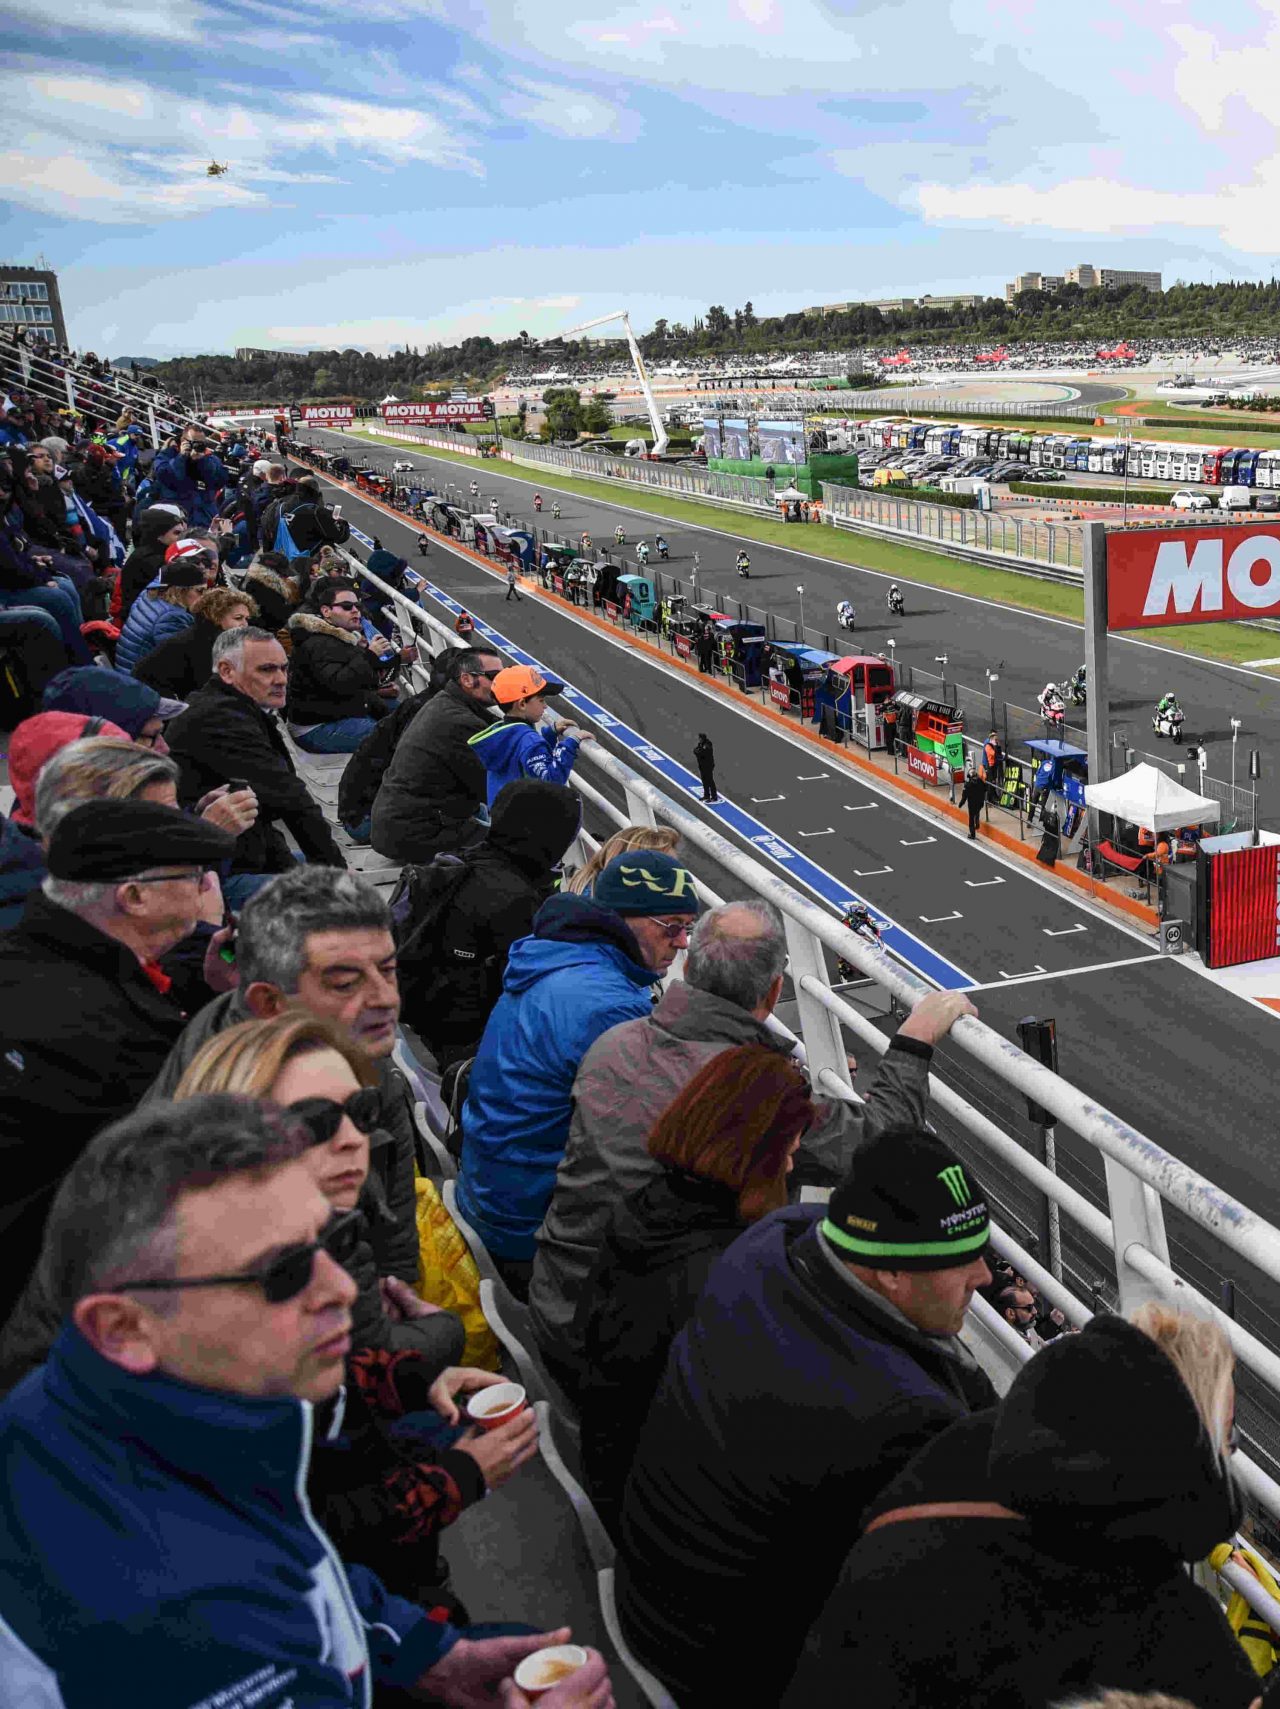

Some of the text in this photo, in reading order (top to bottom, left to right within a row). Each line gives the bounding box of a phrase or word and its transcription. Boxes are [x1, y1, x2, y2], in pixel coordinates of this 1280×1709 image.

[305, 407, 353, 418] MOTUL
[385, 405, 432, 416] MOTUL
[436, 404, 481, 415] MOTUL
[770, 685, 788, 703] Lenovo
[909, 752, 934, 777] Lenovo
[1169, 930, 1179, 939] 60
